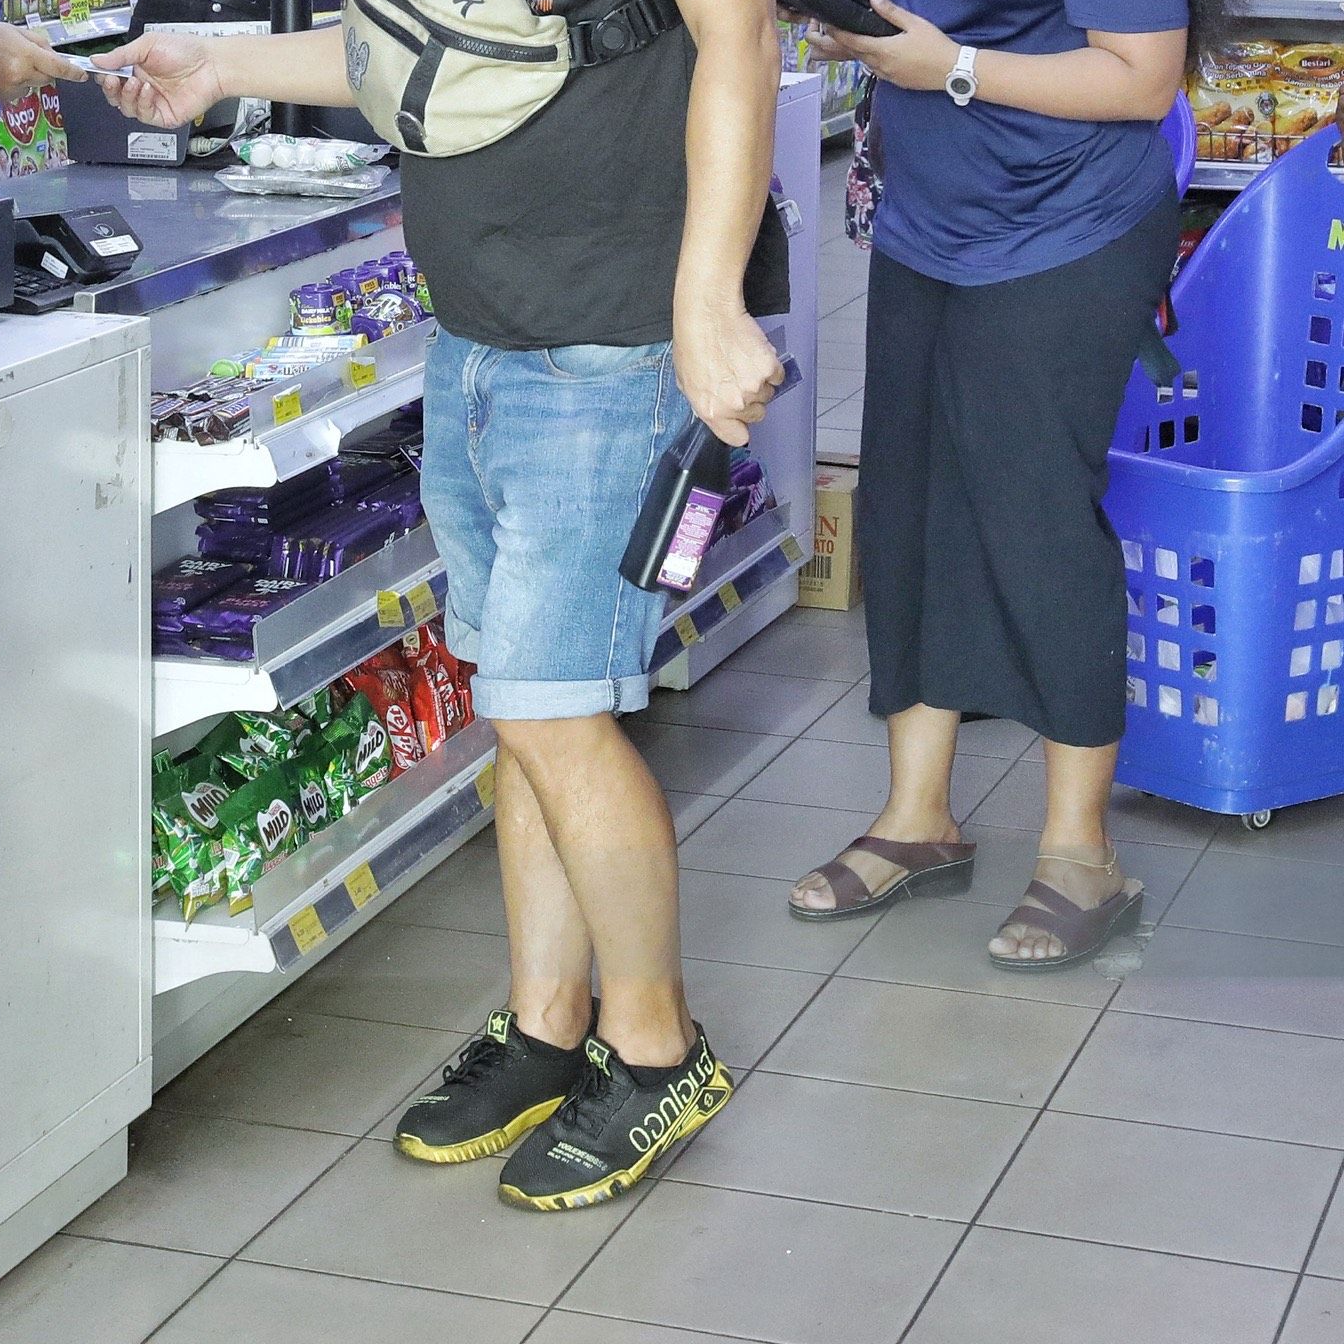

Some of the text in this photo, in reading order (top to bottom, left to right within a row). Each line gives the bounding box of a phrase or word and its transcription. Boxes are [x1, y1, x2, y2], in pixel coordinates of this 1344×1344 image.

[1301, 59, 1331, 67] Bestari
[357, 729, 384, 768] MILO
[304, 797, 324, 817] MILO
[262, 812, 289, 848] MILO
